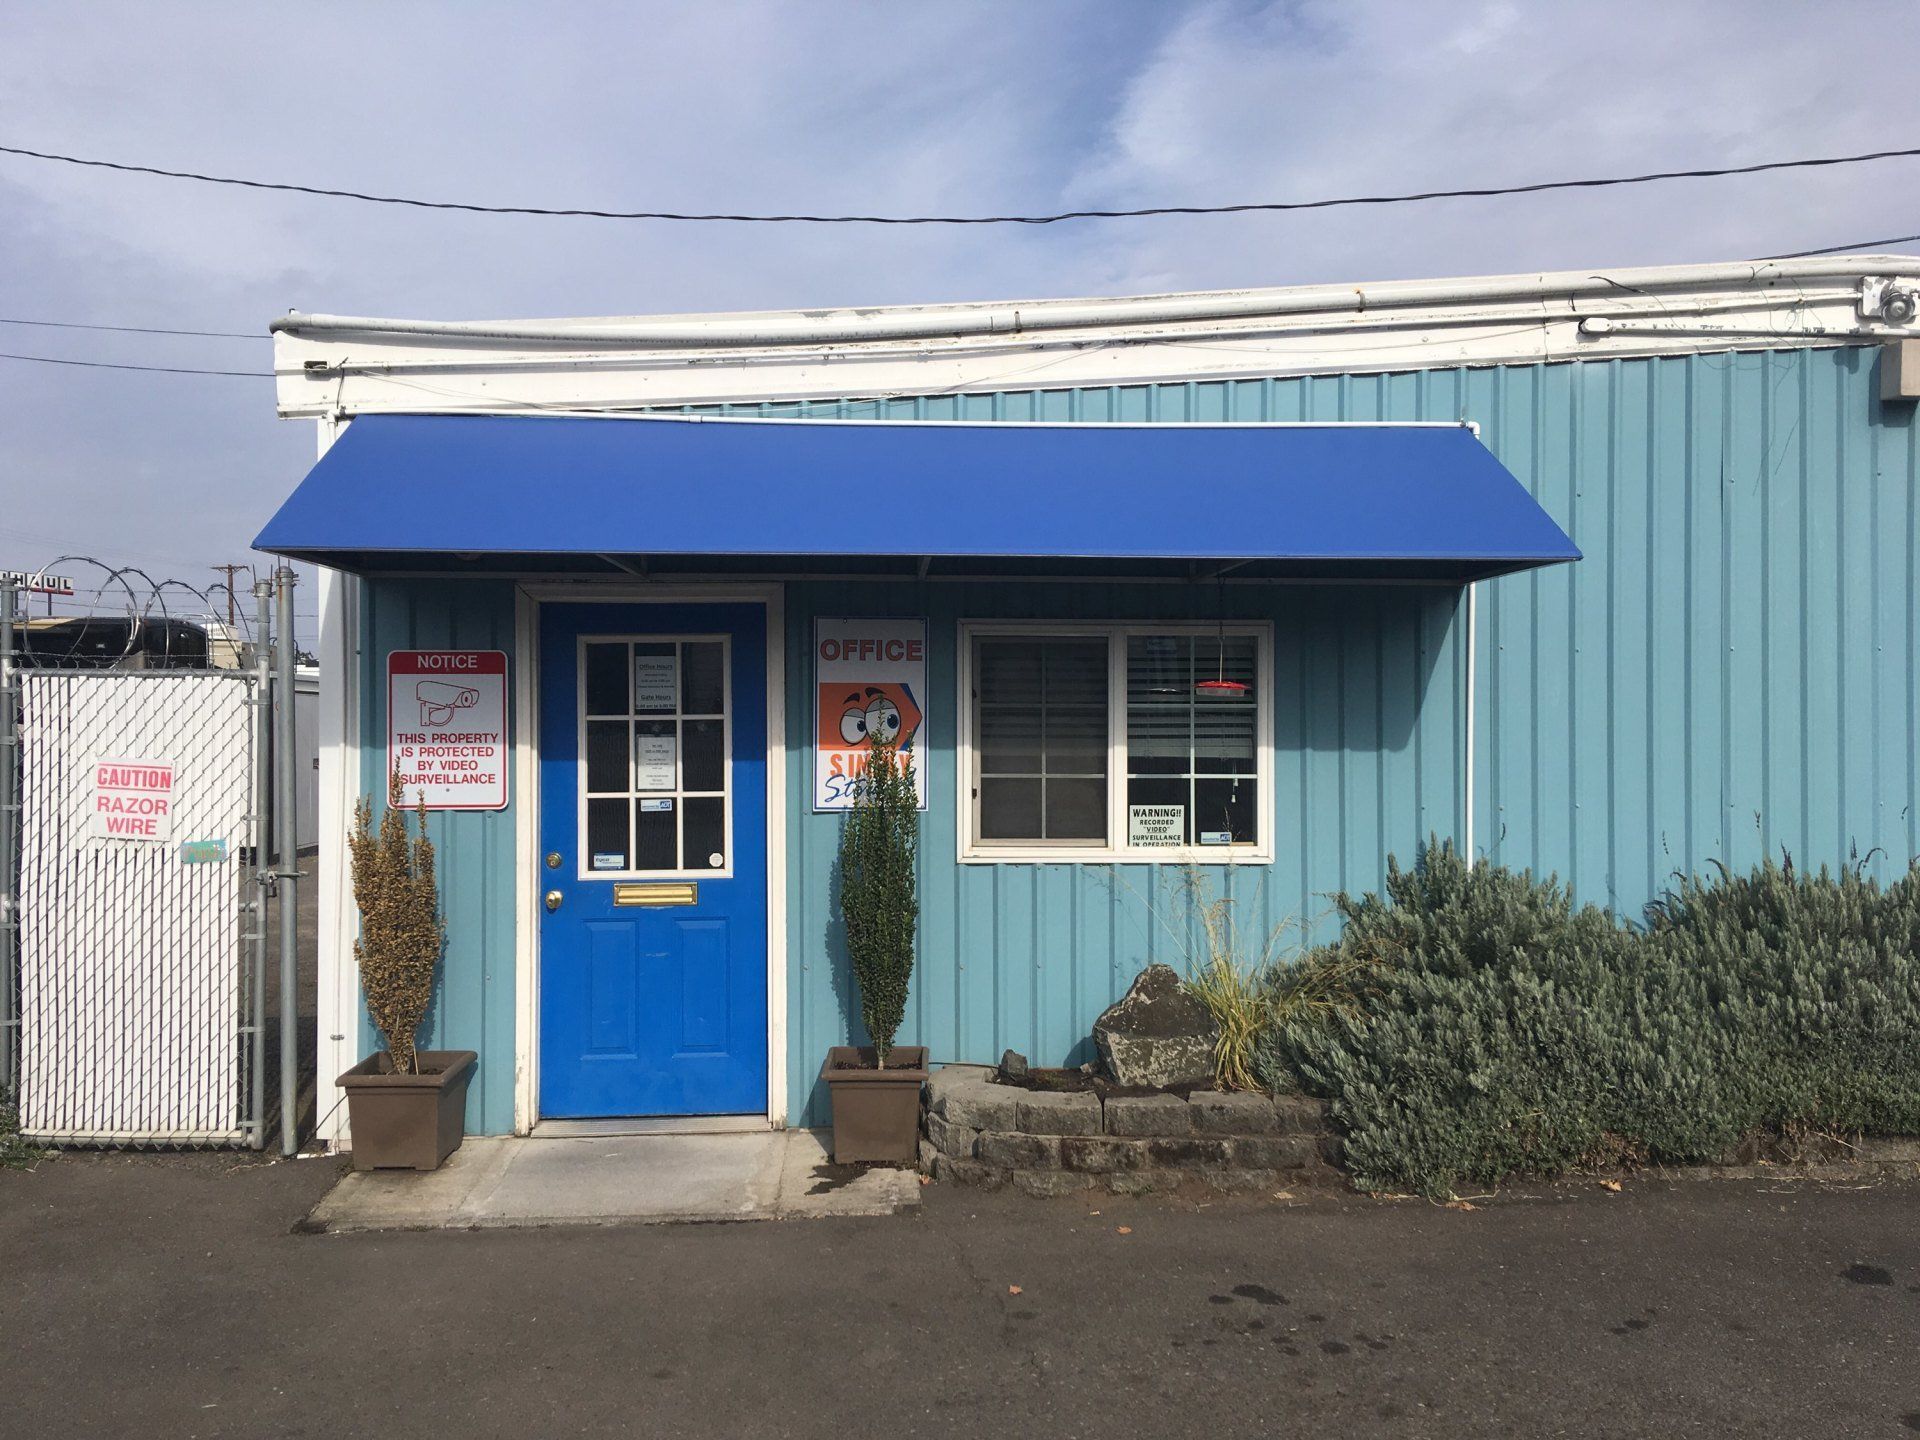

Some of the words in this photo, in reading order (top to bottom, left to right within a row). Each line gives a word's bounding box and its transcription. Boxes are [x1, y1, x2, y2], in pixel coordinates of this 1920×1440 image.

[820, 639, 922, 661] OFFICE
[417, 655, 478, 668] NOTICE
[397, 733, 426, 743] THIS
[431, 733, 498, 743] PROPERTY
[401, 747, 413, 757] IS
[419, 747, 494, 757] PROTECTED
[417, 760, 434, 770] BY
[440, 760, 478, 770] VIDEO
[97, 768, 171, 788] CAUTION
[400, 774, 496, 784] SURVEILLANCE
[97, 796, 168, 815] RAZOR
[1133, 809, 1181, 817] WARNING!!
[106, 817, 157, 835] WIRE
